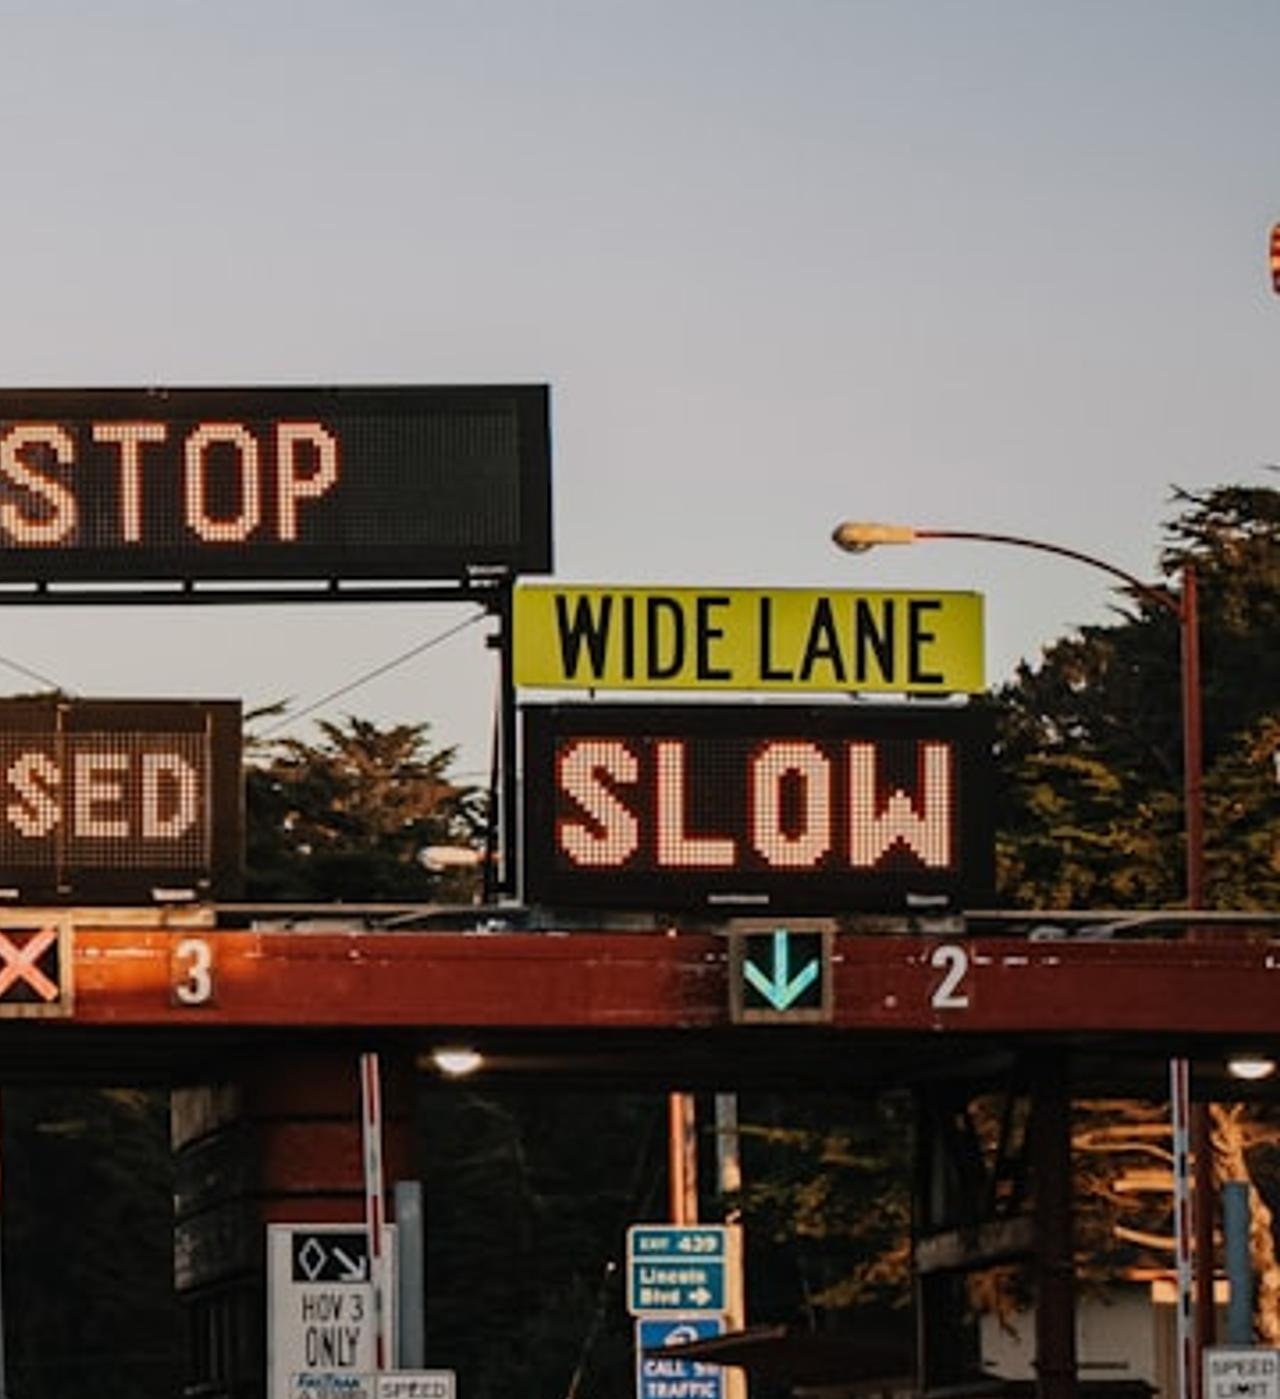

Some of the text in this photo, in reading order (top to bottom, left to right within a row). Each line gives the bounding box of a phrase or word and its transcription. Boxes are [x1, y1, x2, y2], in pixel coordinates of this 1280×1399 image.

[0, 422, 338, 543] STOP
[556, 594, 943, 685] WIDE LANE
[557, 740, 955, 868] SLOW
[177, 939, 212, 1004] 3
[930, 944, 969, 1008] 2
[301, 1294, 365, 1322] HOV 3
[305, 1326, 361, 1367] ONLY
[643, 1359, 690, 1378] CALL
[1212, 1360, 1276, 1376] SPEED
[382, 1381, 446, 1398] SPEED
[646, 1381, 717, 1399] TRAFFIC
[1216, 1383, 1269, 1399] LIMIT
